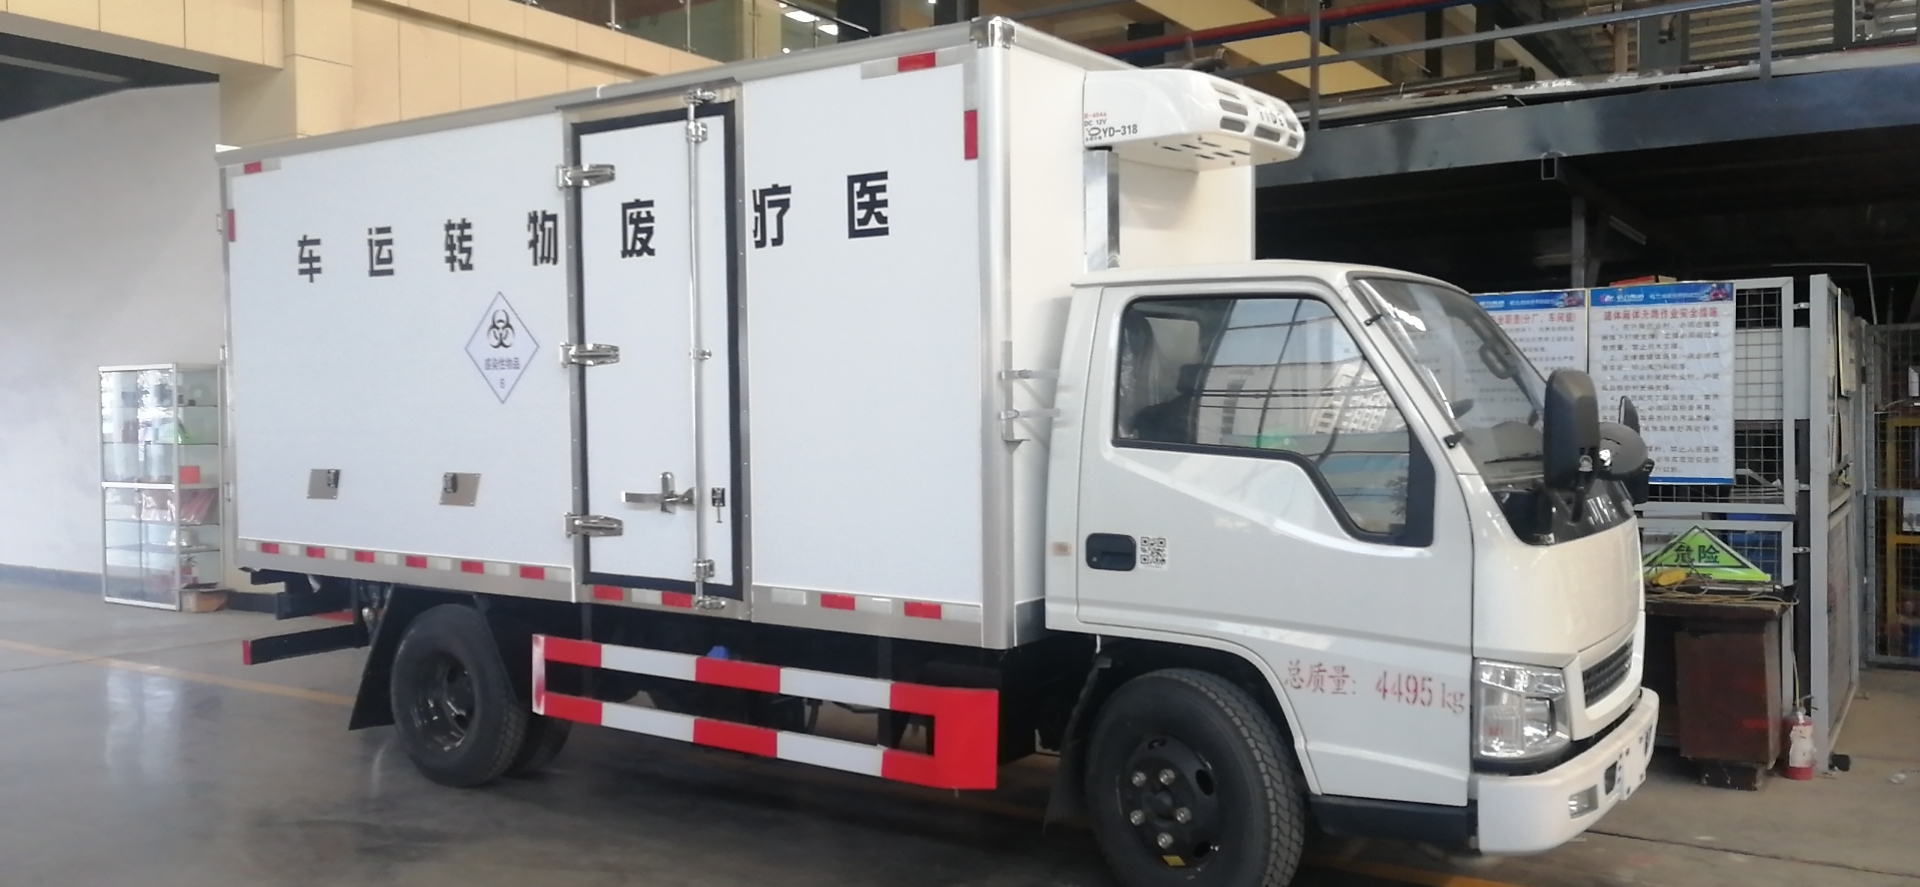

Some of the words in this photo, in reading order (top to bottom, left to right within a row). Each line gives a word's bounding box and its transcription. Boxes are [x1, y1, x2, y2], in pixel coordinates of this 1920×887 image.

[1096, 118, 1107, 126] 12V
[1102, 124, 1138, 138] YD-318
[1673, 544, 1720, 564] 危险
[1283, 659, 1356, 697] 总质量:
[1374, 671, 1433, 707] 4495
[1441, 683, 1466, 715] kg
